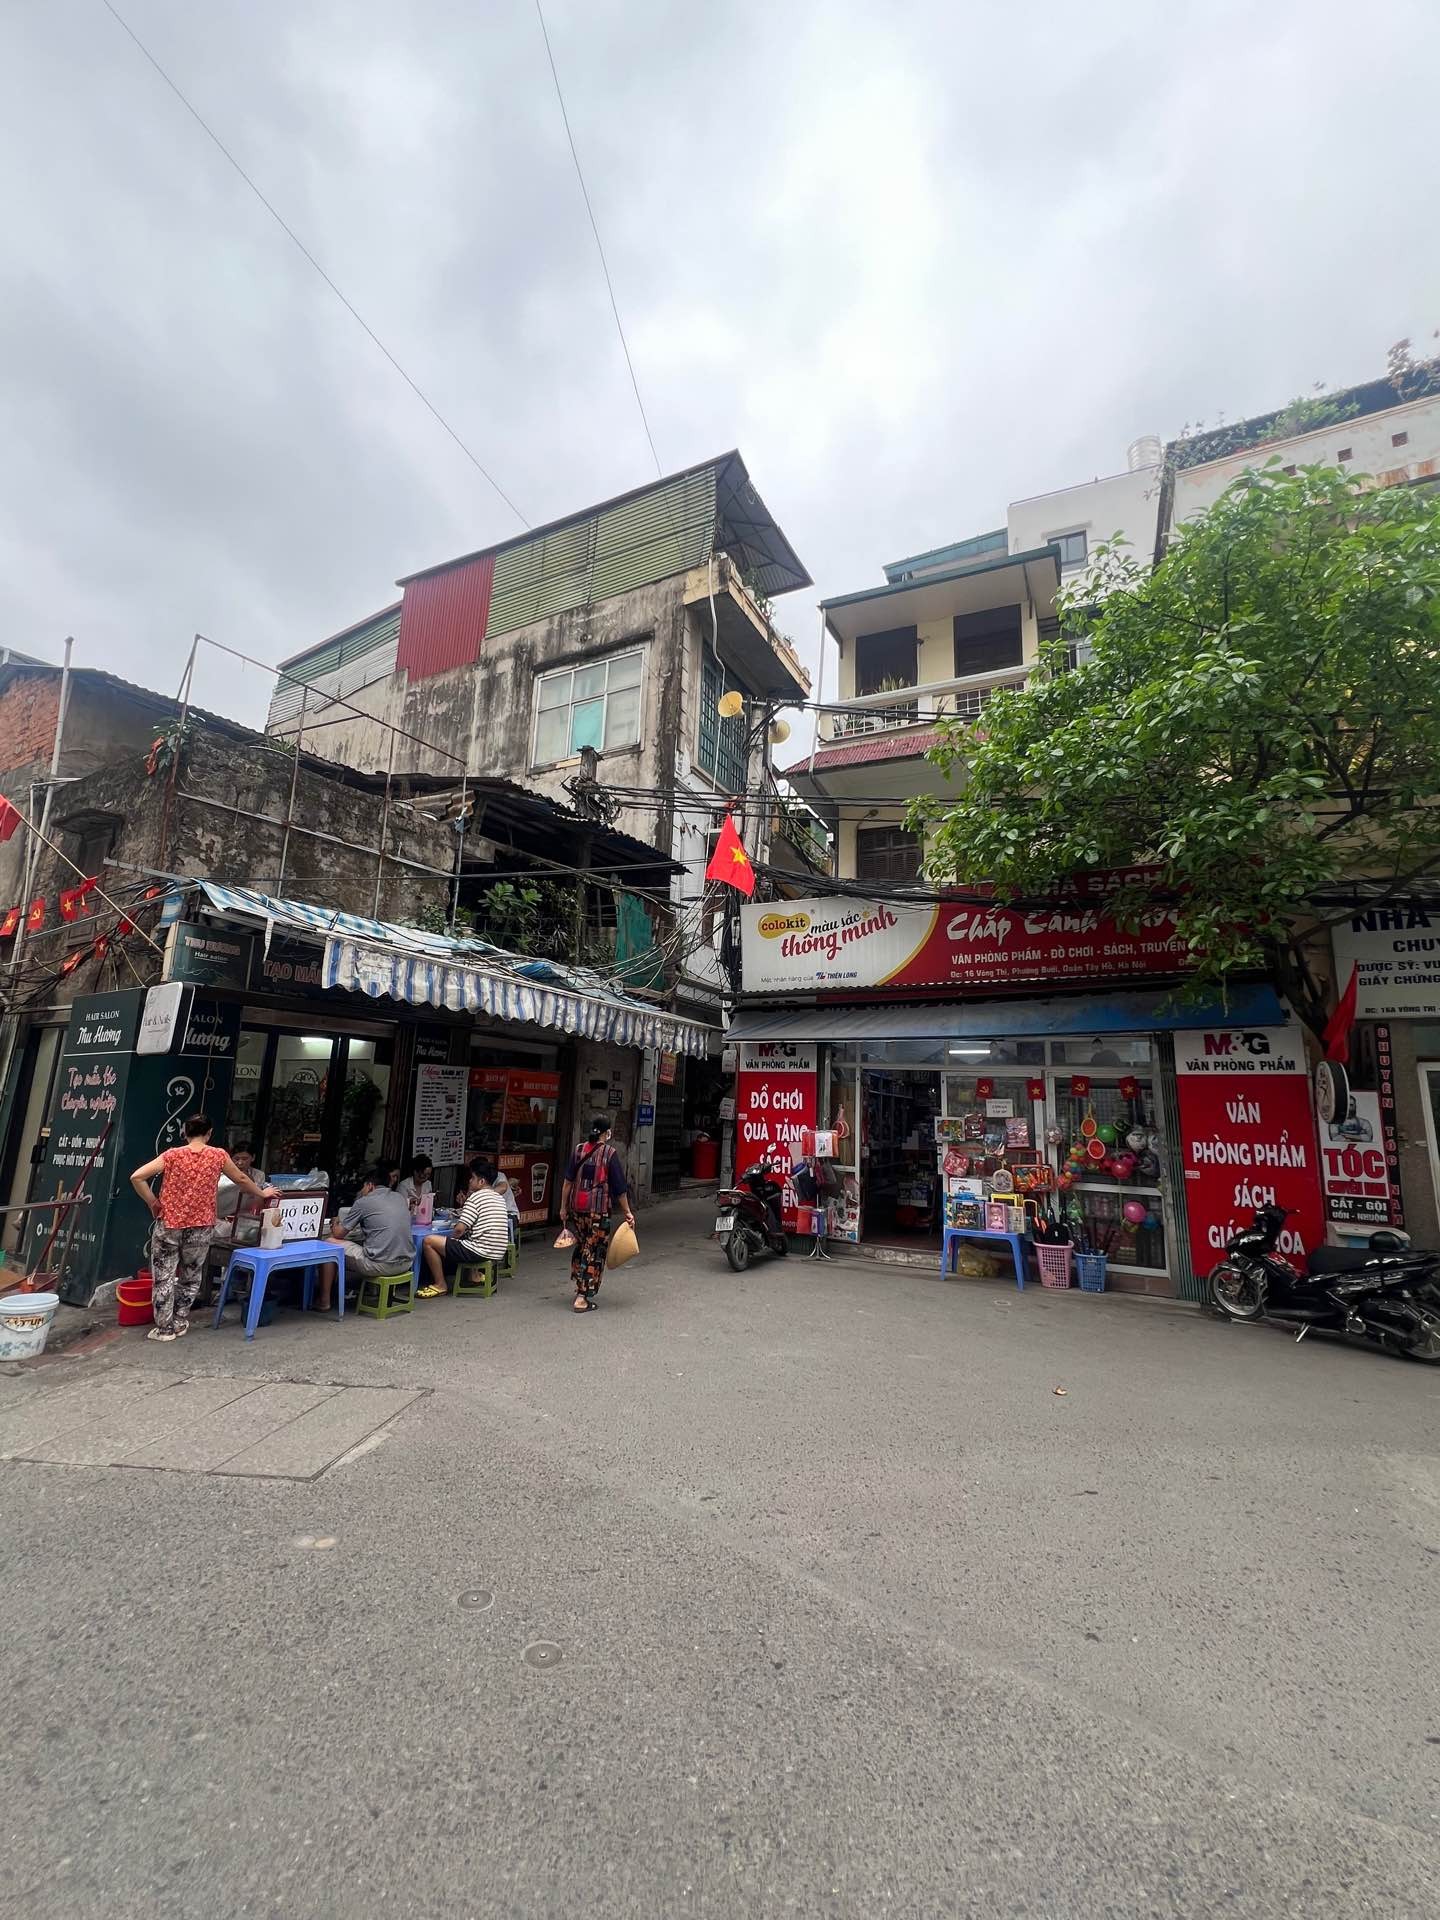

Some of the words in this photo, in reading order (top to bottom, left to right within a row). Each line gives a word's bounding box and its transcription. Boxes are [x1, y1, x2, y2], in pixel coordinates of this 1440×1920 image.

[761, 918, 806, 931] colokit
[810, 920, 839, 935] màu
[841, 910, 862, 928] sắc
[781, 931, 842, 961] thông
[841, 905, 898, 944] minh
[946, 902, 1012, 946] Chắp
[1024, 909, 1098, 935] Cánh
[194, 951, 210, 959] Hair
[263, 961, 293, 983] TẠO
[964, 970, 974, 978] 16
[85, 1010, 99, 1021] HAIR
[100, 1009, 120, 1020] SALON
[76, 1027, 93, 1045] Thu
[93, 1024, 122, 1046] Hương
[1203, 1031, 1271, 1056] M&G
[761, 1058, 788, 1069] PHÒNG
[1213, 1058, 1255, 1071] PHÒNG
[750, 1083, 769, 1109] ĐỒ
[772, 1088, 803, 1110] CHƠI
[1225, 1093, 1261, 1124] VĂN
[743, 1117, 769, 1143] QUÀ
[1192, 1133, 1252, 1166] PHÒNG
[1253, 1129, 1307, 1168] PHẨM
[1323, 1143, 1386, 1180] TÓC
[1234, 1178, 1276, 1208] SÁCH
[302, 1201, 319, 1215] BÒ
